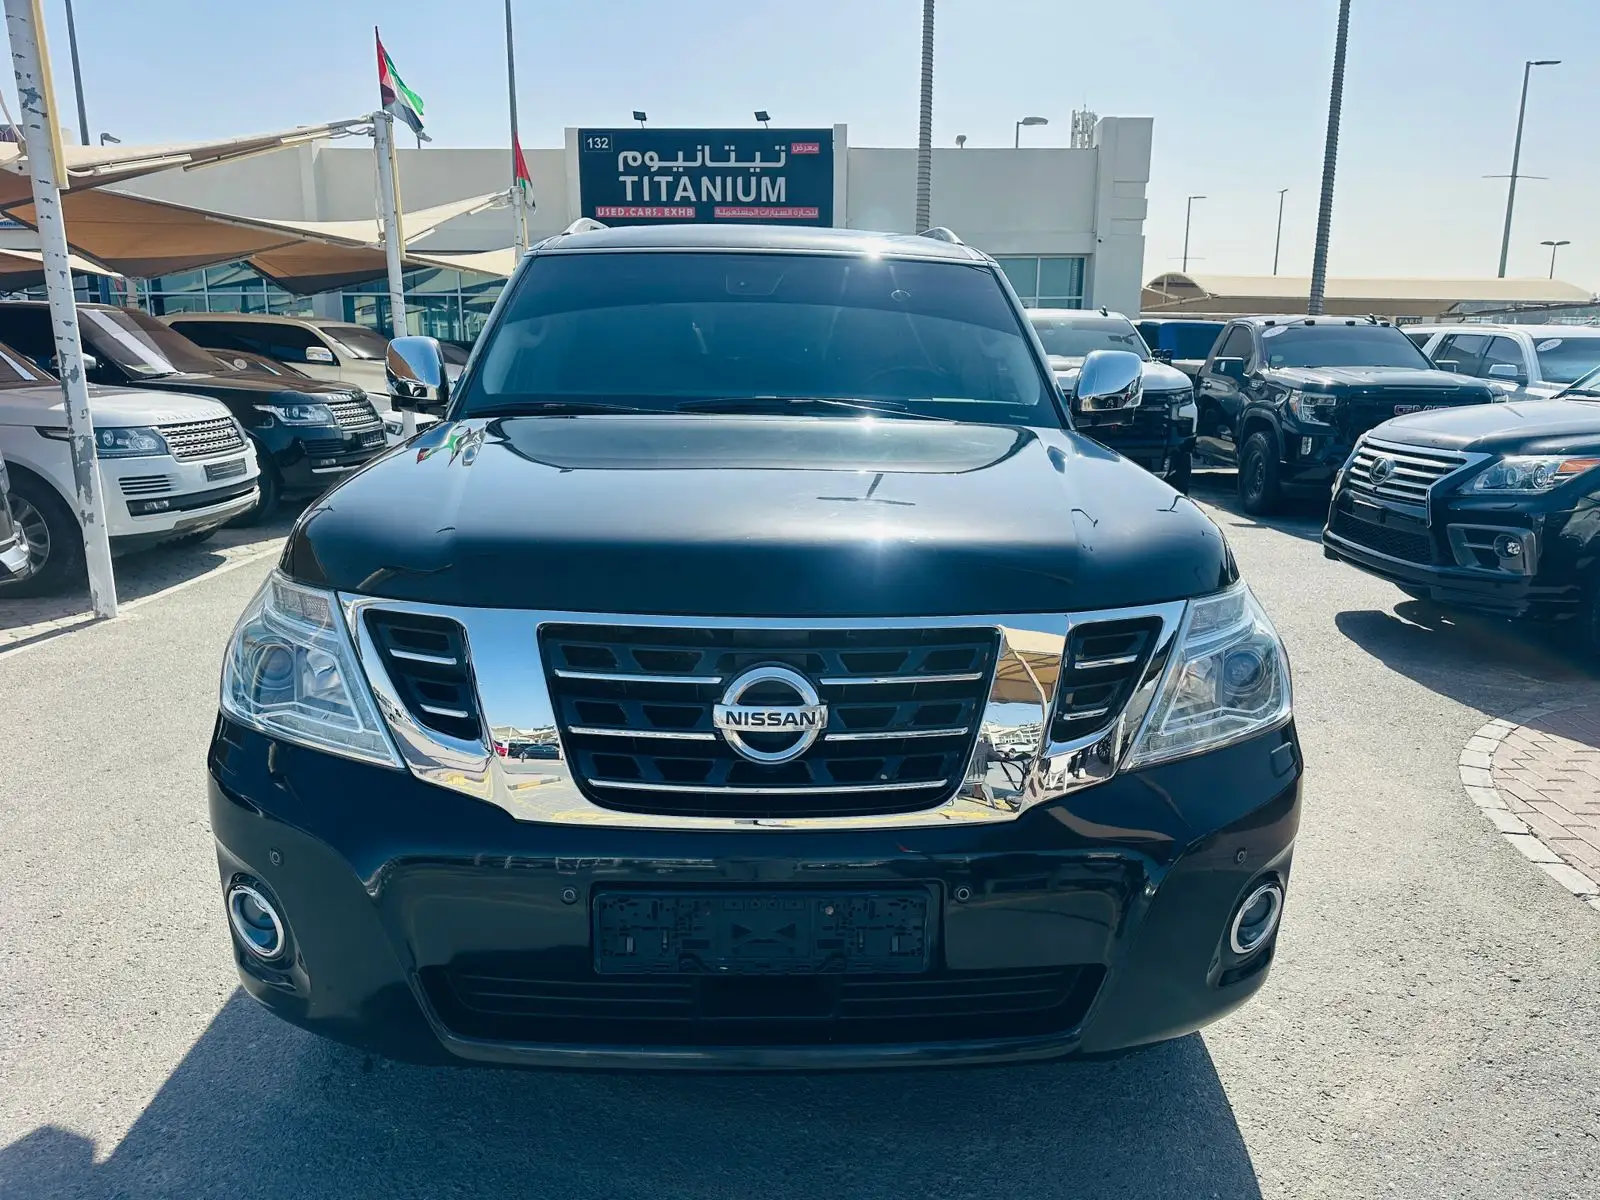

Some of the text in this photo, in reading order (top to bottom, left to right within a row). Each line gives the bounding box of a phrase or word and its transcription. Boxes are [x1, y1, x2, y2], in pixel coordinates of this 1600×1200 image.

[587, 137, 609, 149] 132
[618, 145, 786, 172] تيتانيوم
[618, 175, 786, 202] TITANIUM
[726, 711, 816, 726] NISSAN
